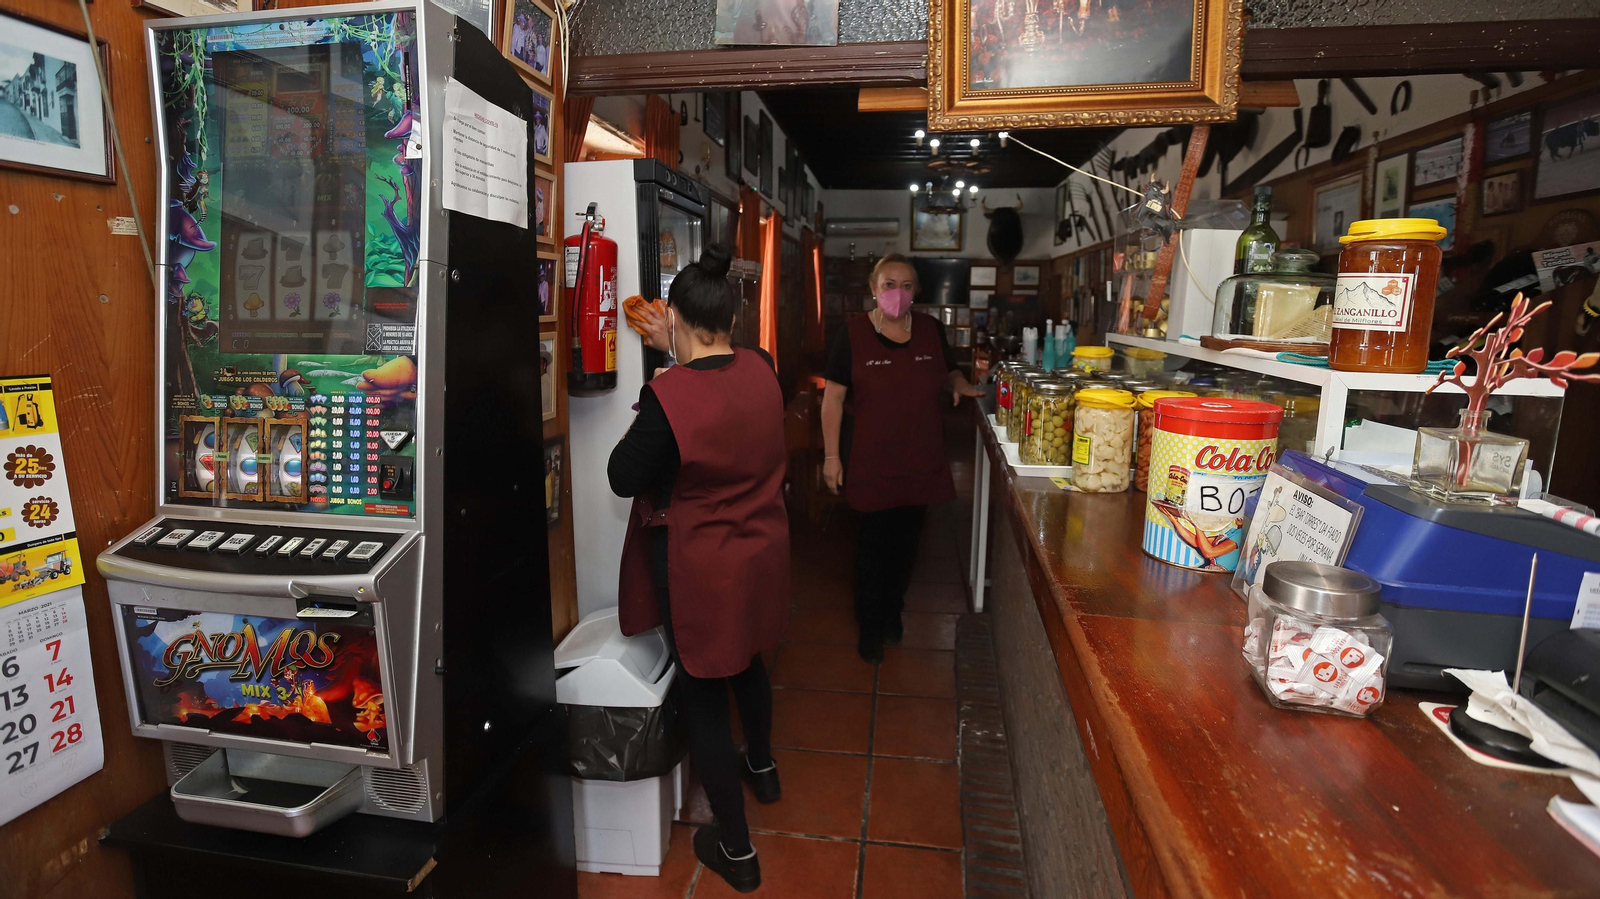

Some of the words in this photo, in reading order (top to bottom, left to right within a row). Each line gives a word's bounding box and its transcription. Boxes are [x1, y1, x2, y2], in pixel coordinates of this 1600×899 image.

[1542, 249, 1570, 260] Miguel
[1542, 258, 1575, 268] Tendero
[1337, 308, 1397, 318] ZANGANILLO
[15, 458, 39, 474] 25
[1293, 490, 1314, 508] AVISO:
[30, 504, 51, 520] 24
[1289, 504, 1296, 517] EL
[1319, 520, 1328, 536] DA
[1328, 526, 1342, 543] FIADO
[1287, 524, 1297, 536] DOS
[1295, 528, 1308, 544] VECES
[1305, 536, 1317, 552] POR
[19, 606, 38, 615] MARZO
[40, 632, 63, 643] DOMINGO
[0, 648, 17, 656] ABADO
[2, 656, 20, 678] 6
[46, 639, 61, 661] 7
[0, 684, 29, 711] 13
[44, 667, 73, 693] 14
[241, 684, 271, 698] MIX
[277, 687, 287, 700] 3
[0, 714, 37, 745] 20
[50, 695, 75, 722] 21
[6, 741, 39, 775] 27
[50, 723, 83, 753] 28
